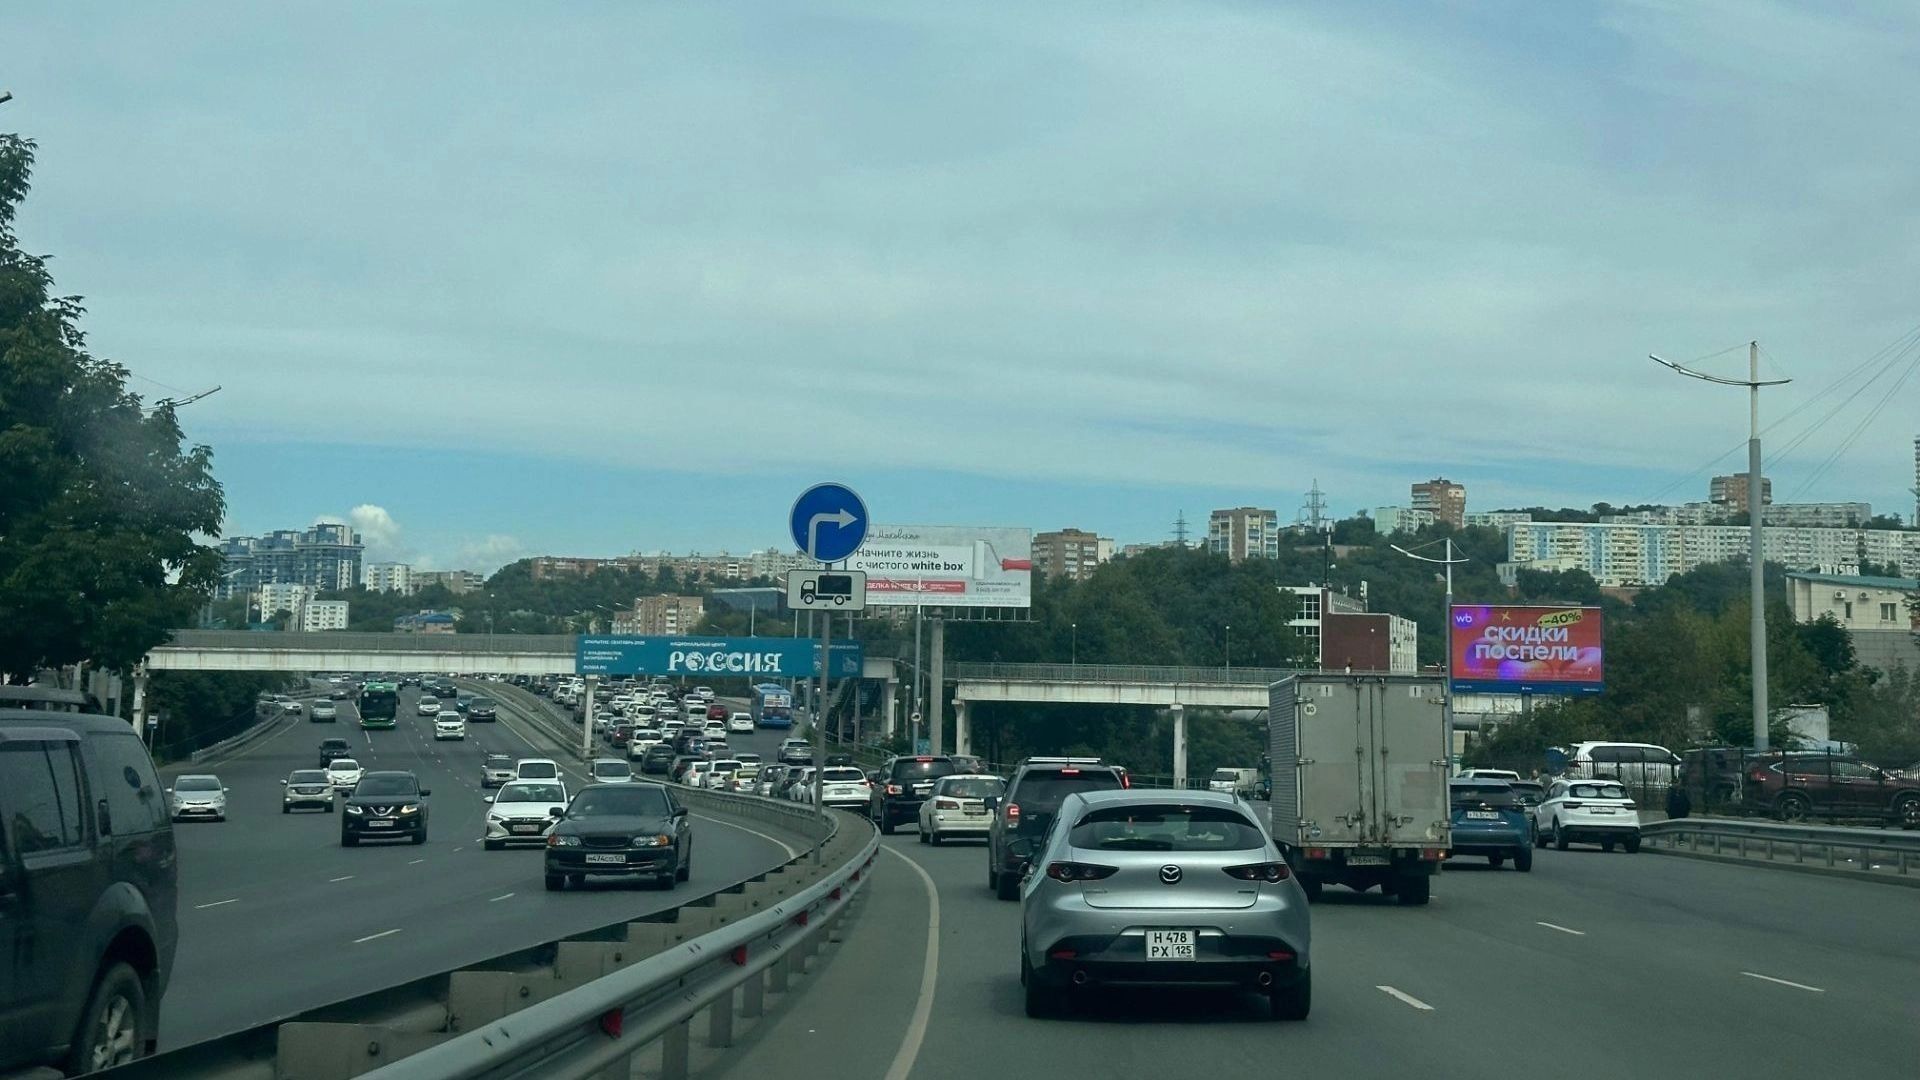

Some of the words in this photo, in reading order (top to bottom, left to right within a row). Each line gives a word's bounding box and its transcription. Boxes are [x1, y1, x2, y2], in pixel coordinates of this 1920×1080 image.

[857, 549, 903, 559] Начните
[906, 550, 940, 559] жизнь
[856, 561, 863, 570] с
[866, 562, 909, 570] чистого
[911, 561, 941, 571] white
[1455, 612, 1473, 623] wb
[1544, 611, 1582, 625] -40%
[667, 651, 783, 673] РОССИЯ
[1154, 931, 1162, 943] Н
[1166, 932, 1187, 943] 478
[1152, 946, 1169, 957] РХ
[1175, 945, 1192, 955] 125
